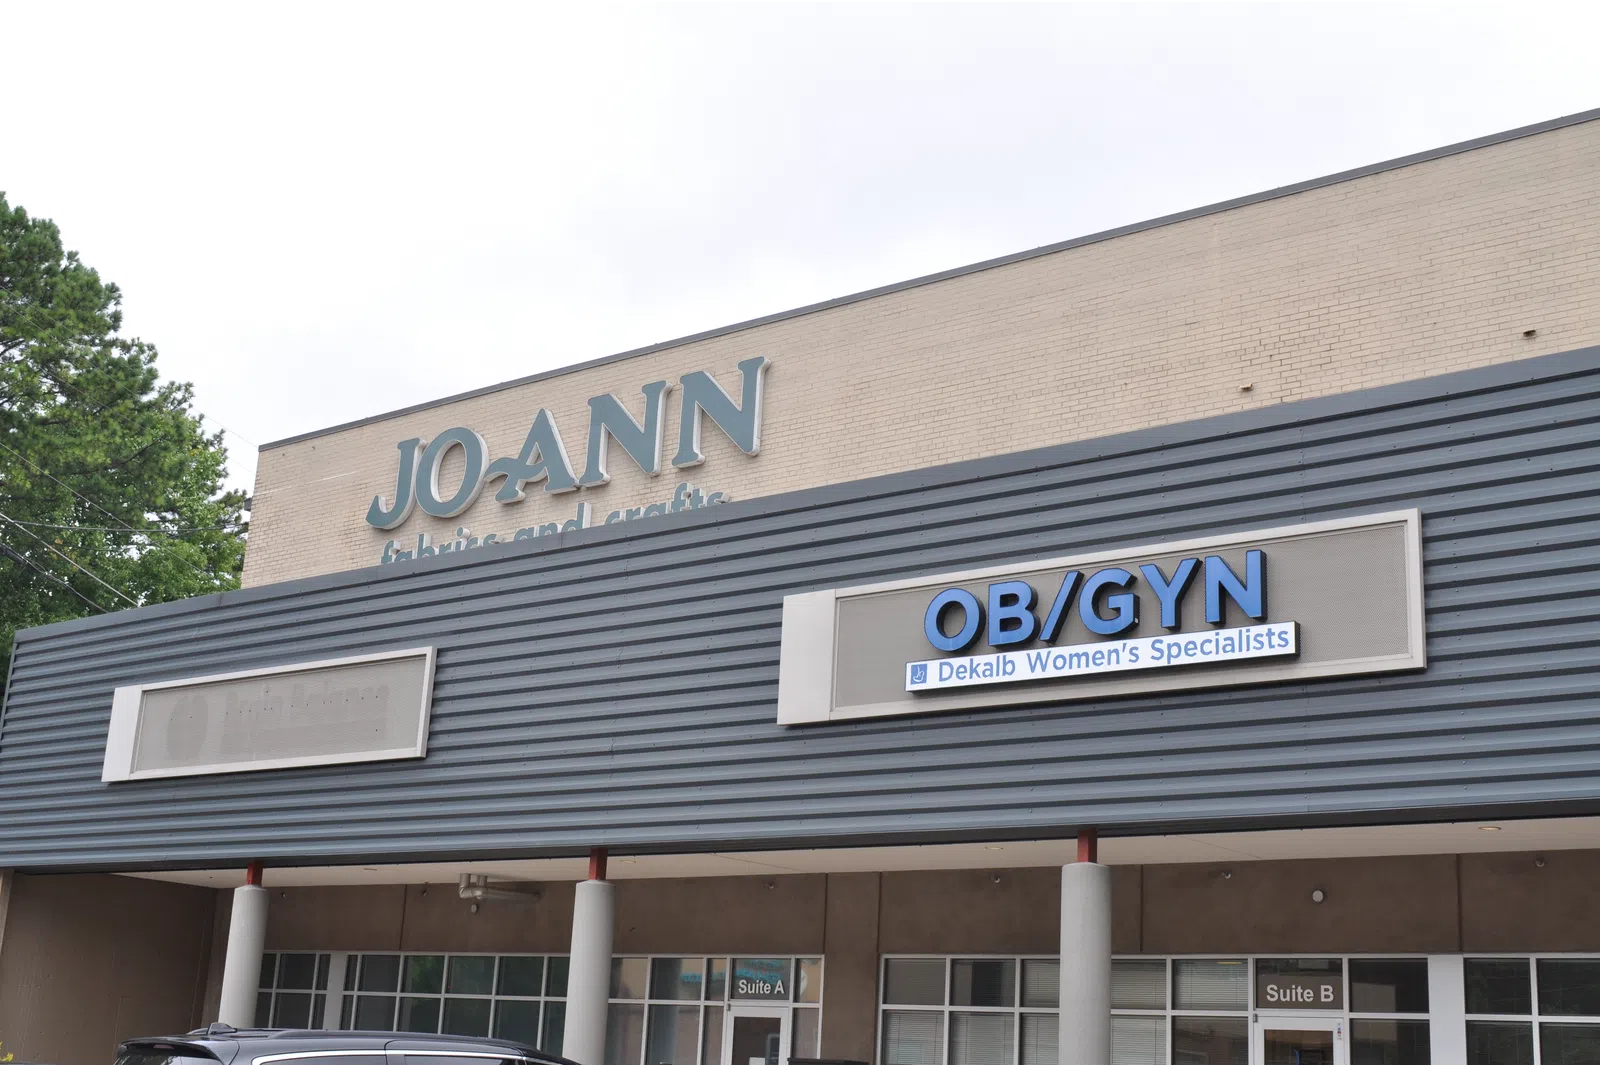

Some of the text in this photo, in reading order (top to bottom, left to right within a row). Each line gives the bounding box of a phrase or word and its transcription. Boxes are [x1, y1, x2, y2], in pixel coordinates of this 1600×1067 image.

[924, 549, 1268, 653] OB/GYN
[938, 626, 1290, 682] Dekalb Women's Specialists
[738, 979, 785, 994] Suite A
[1265, 984, 1335, 1003] Suite B
